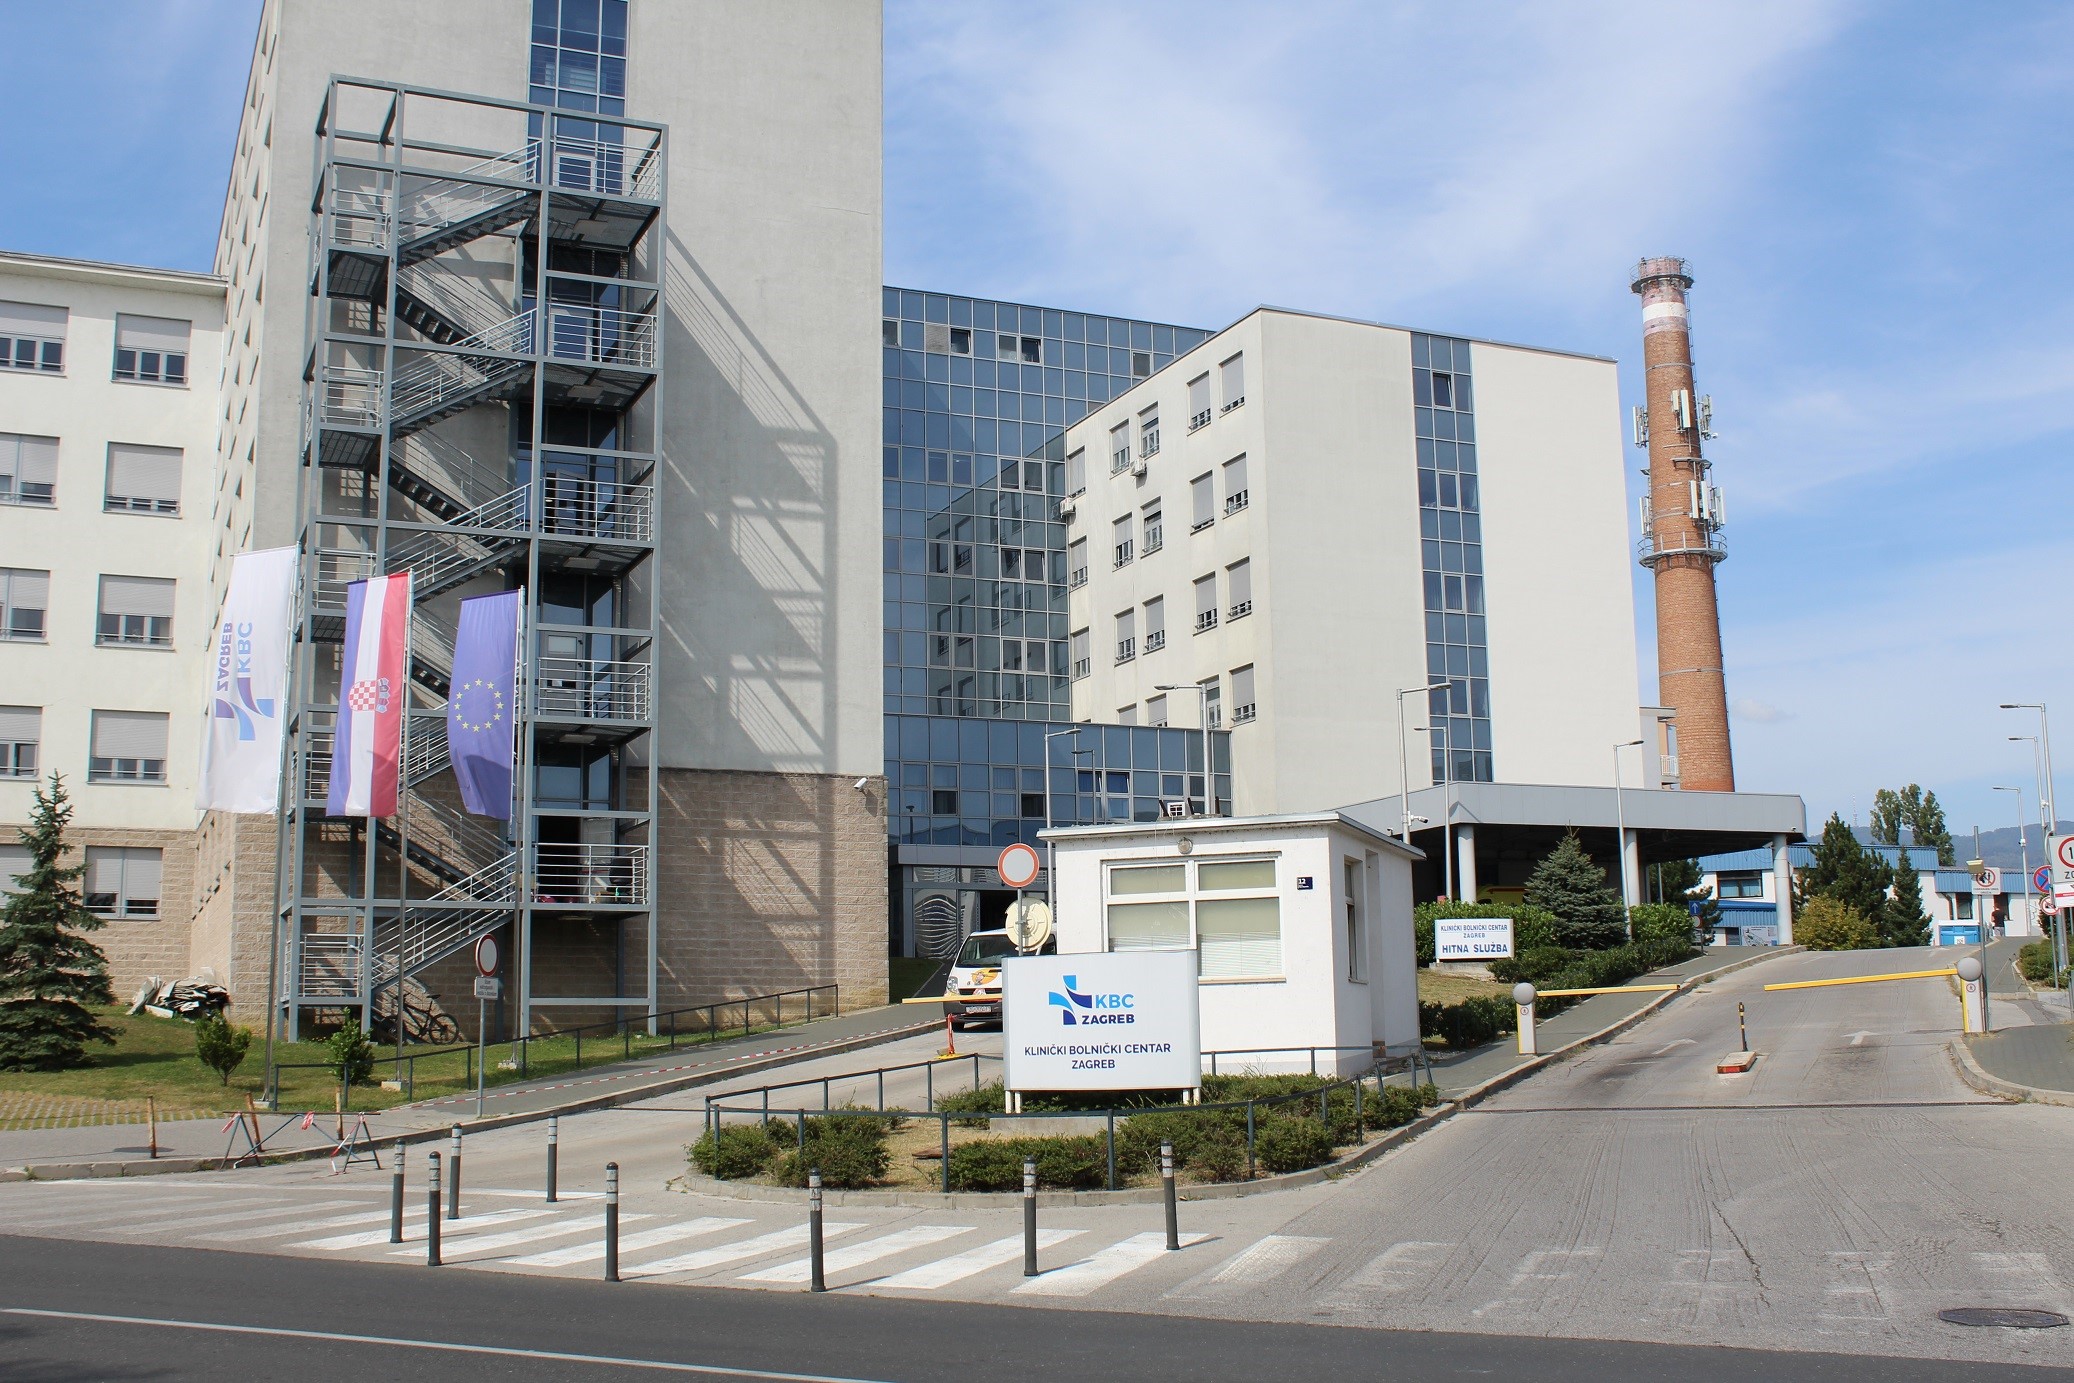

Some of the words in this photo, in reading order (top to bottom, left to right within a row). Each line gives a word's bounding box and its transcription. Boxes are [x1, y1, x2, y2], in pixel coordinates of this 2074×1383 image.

[2068, 846, 2074, 860] 1
[1463, 922, 1488, 931] BOLNIČKI
[1442, 944, 1469, 953] HITNA
[1473, 941, 1508, 953] SLUŽBA
[1095, 994, 1135, 1009] KBC
[1081, 1013, 1135, 1025] ZAGREB
[1024, 1043, 1067, 1056] KLINIČKI
[1069, 1042, 1122, 1055] BOLNIČKI
[1124, 1043, 1172, 1054] CENTAR
[1071, 1059, 1116, 1070] ZAGREB
